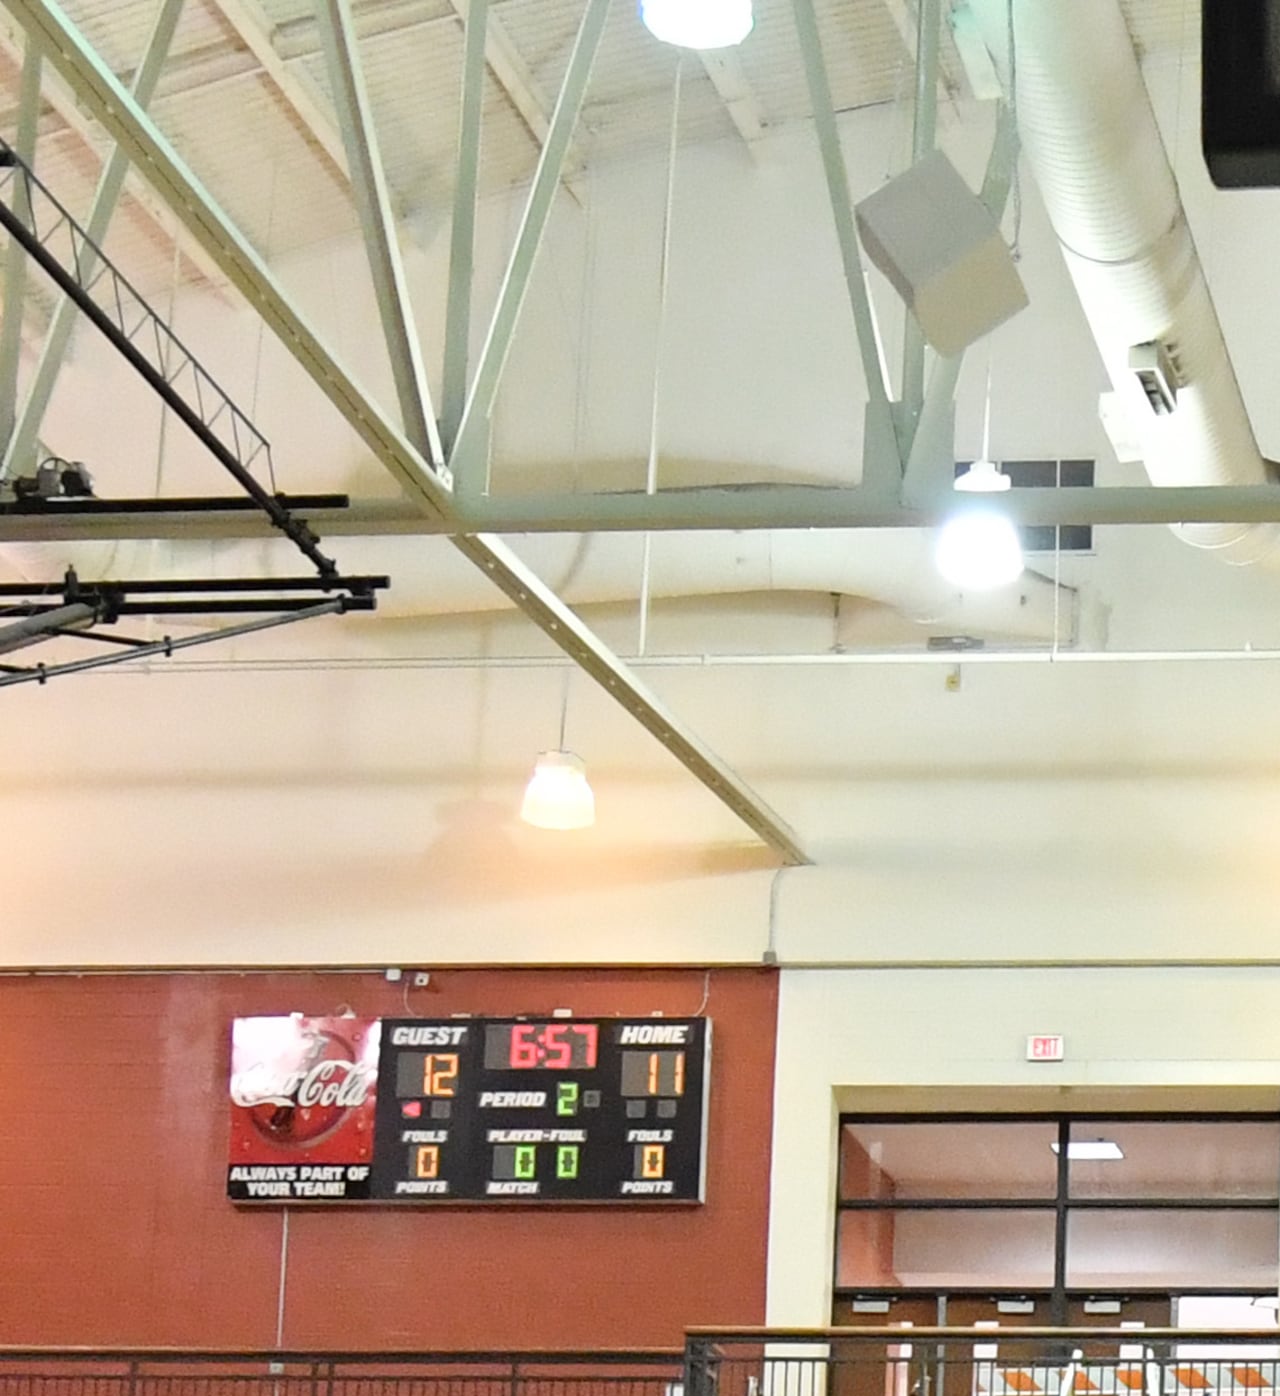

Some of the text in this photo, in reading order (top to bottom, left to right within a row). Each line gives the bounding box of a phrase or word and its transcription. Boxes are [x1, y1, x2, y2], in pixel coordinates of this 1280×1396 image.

[392, 1027, 467, 1045] GUEST
[620, 1025, 689, 1044] HOME
[510, 1024, 598, 1069] 6:57
[424, 1054, 458, 1096] 12
[649, 1053, 685, 1095] 11
[479, 1082, 578, 1116] PERIOD 2
[402, 1130, 448, 1142] FOULS
[627, 1130, 673, 1142] FOULS
[417, 1146, 439, 1178] 0
[515, 1146, 579, 1179] 0 0
[642, 1145, 664, 1178] 0
[230, 1167, 369, 1181] ALWAYS PART OF
[247, 1182, 346, 1196] YOUR TEAM!
[395, 1181, 447, 1193] POINTS
[487, 1182, 539, 1194] MATCH
[621, 1181, 673, 1194] POINTS
